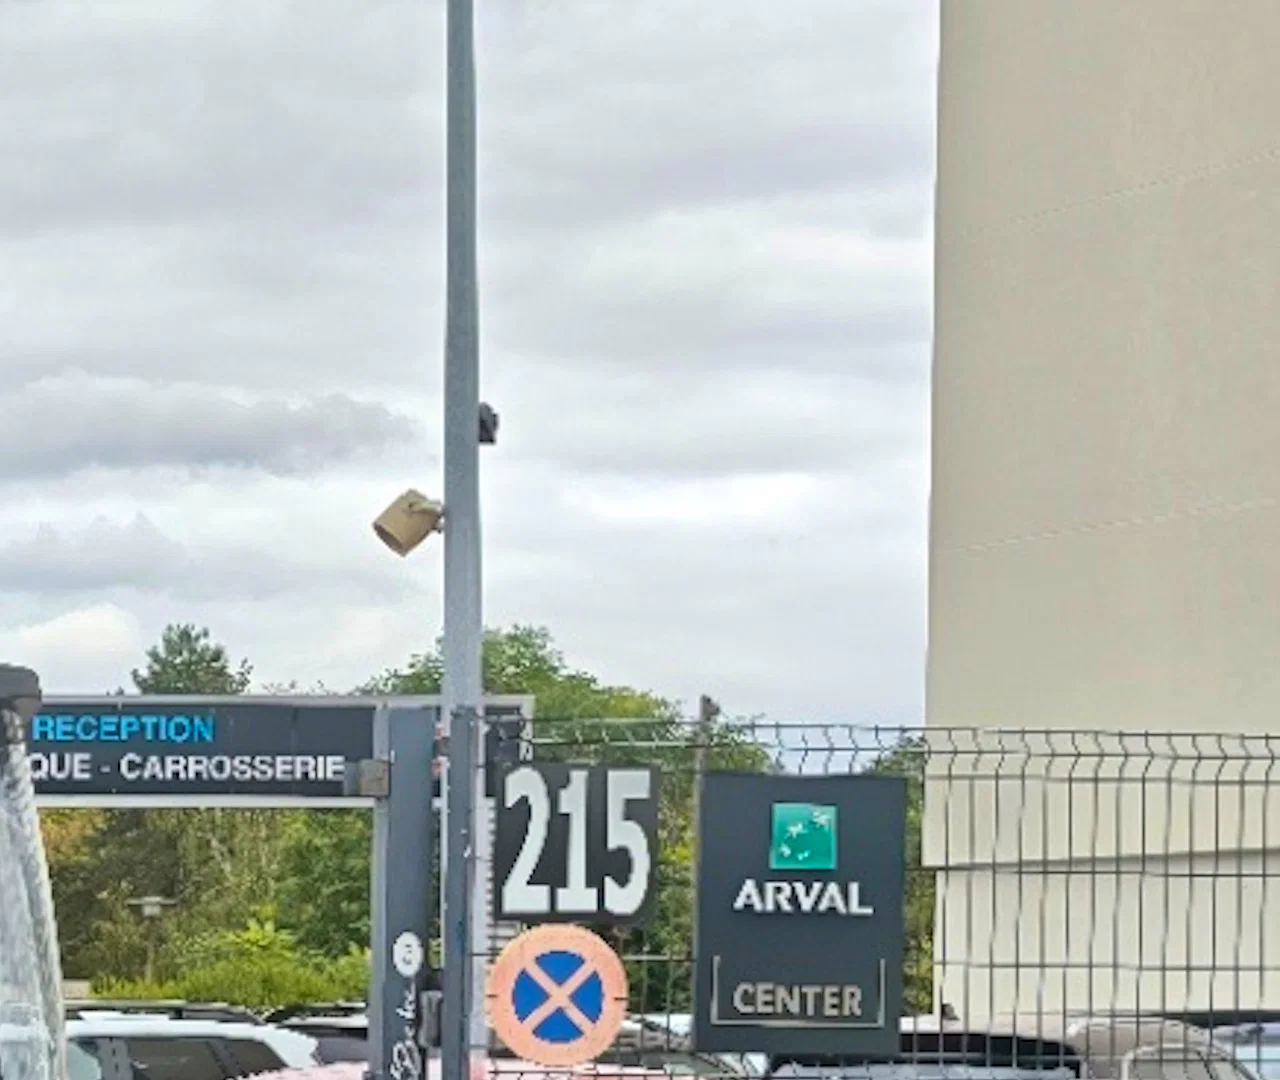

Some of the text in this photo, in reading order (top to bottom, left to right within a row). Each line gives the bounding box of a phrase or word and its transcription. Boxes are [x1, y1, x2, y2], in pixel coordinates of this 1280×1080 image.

[32, 714, 215, 743] RECEPTION
[119, 752, 346, 781] CARROSSERIE
[500, 767, 653, 916] 215
[733, 879, 875, 916] ARVAL
[733, 982, 863, 1018] CENTER
